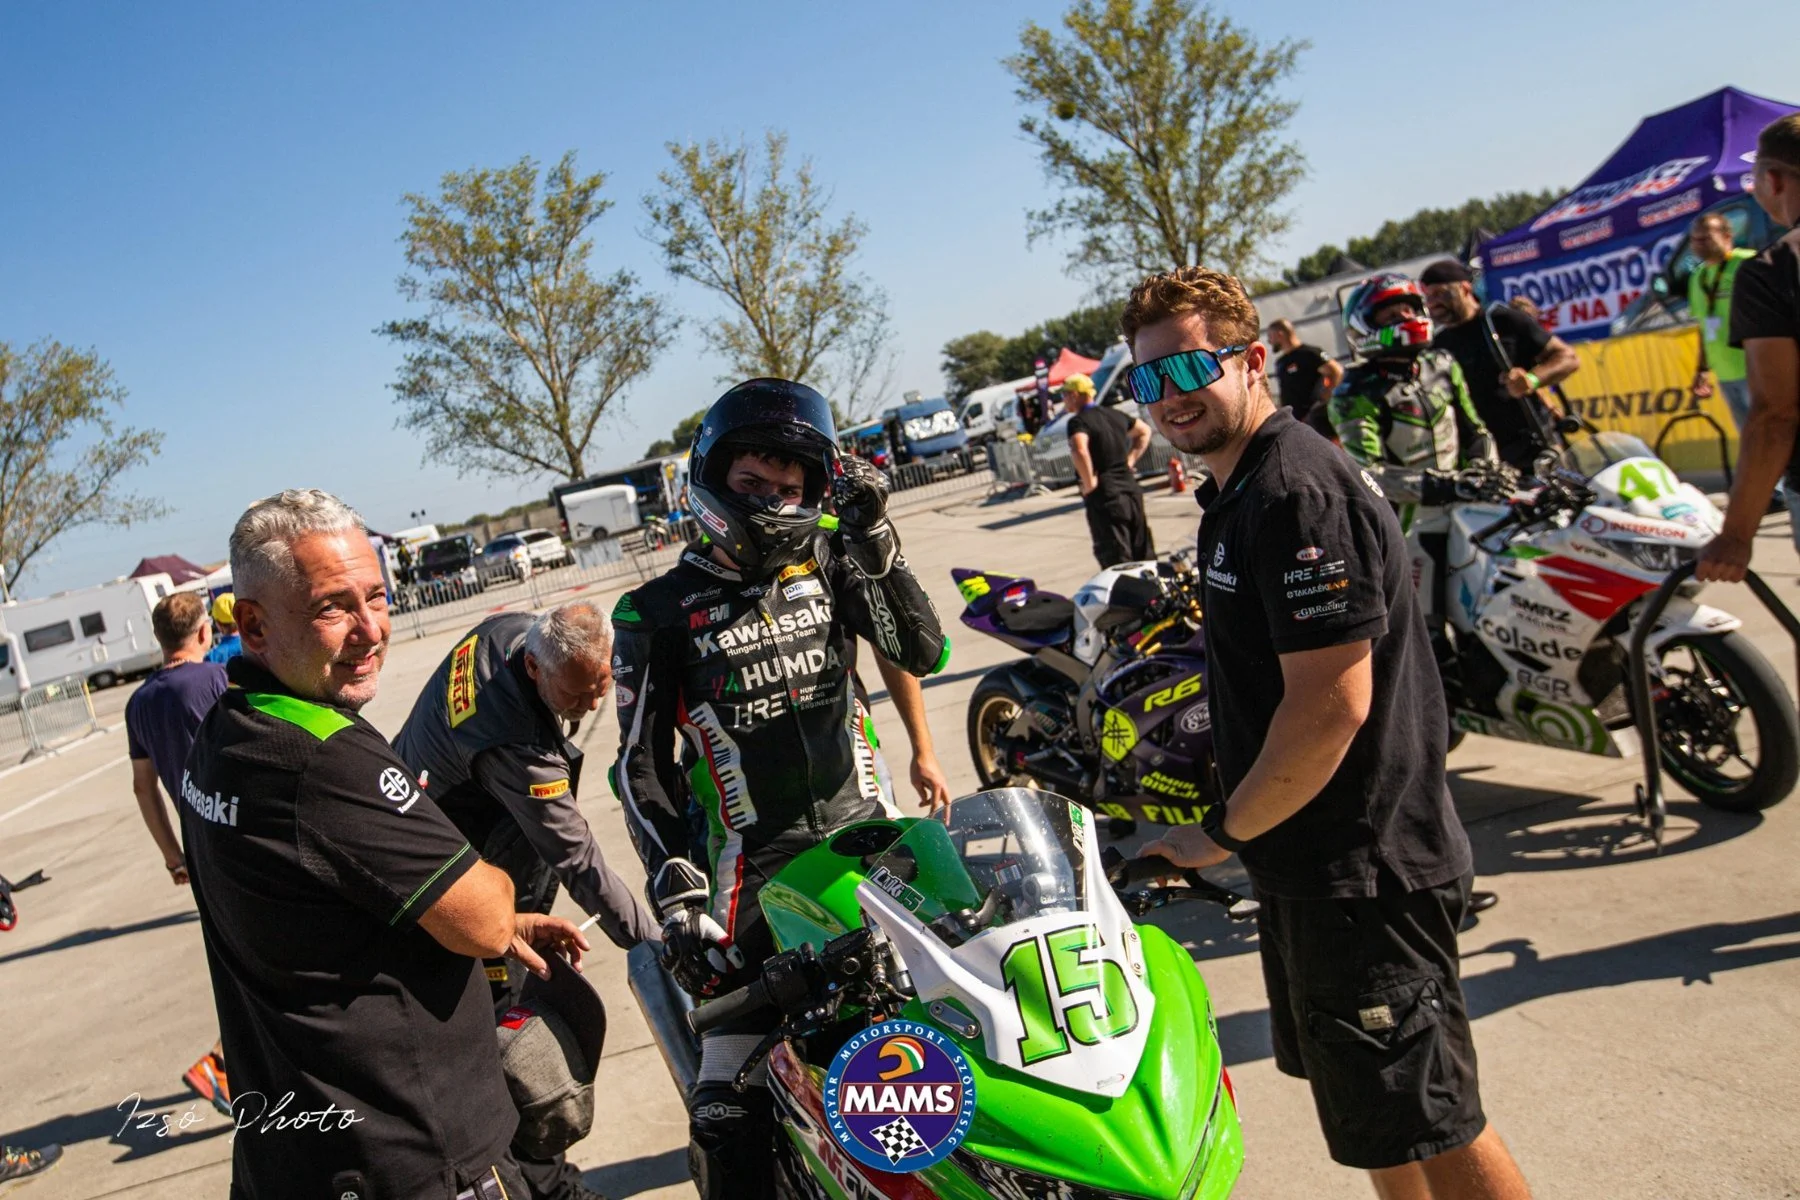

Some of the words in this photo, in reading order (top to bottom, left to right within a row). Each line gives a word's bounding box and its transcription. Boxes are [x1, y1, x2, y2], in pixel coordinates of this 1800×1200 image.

[1569, 300, 1609, 325] NA
[1618, 462, 1676, 502] 47
[691, 556, 726, 575] MASS
[1284, 567, 1314, 585] HRE
[1300, 601, 1348, 616] GBRacing
[694, 600, 832, 659] Kawasaki
[726, 641, 762, 658] Hungary
[795, 627, 817, 639] Team
[450, 642, 471, 716] PIRELLI
[741, 645, 842, 691] HUMDA
[733, 691, 787, 729] HRE
[1144, 672, 1202, 712] R6
[180, 768, 239, 827] Kawasaki
[1000, 923, 1140, 1067] 15
